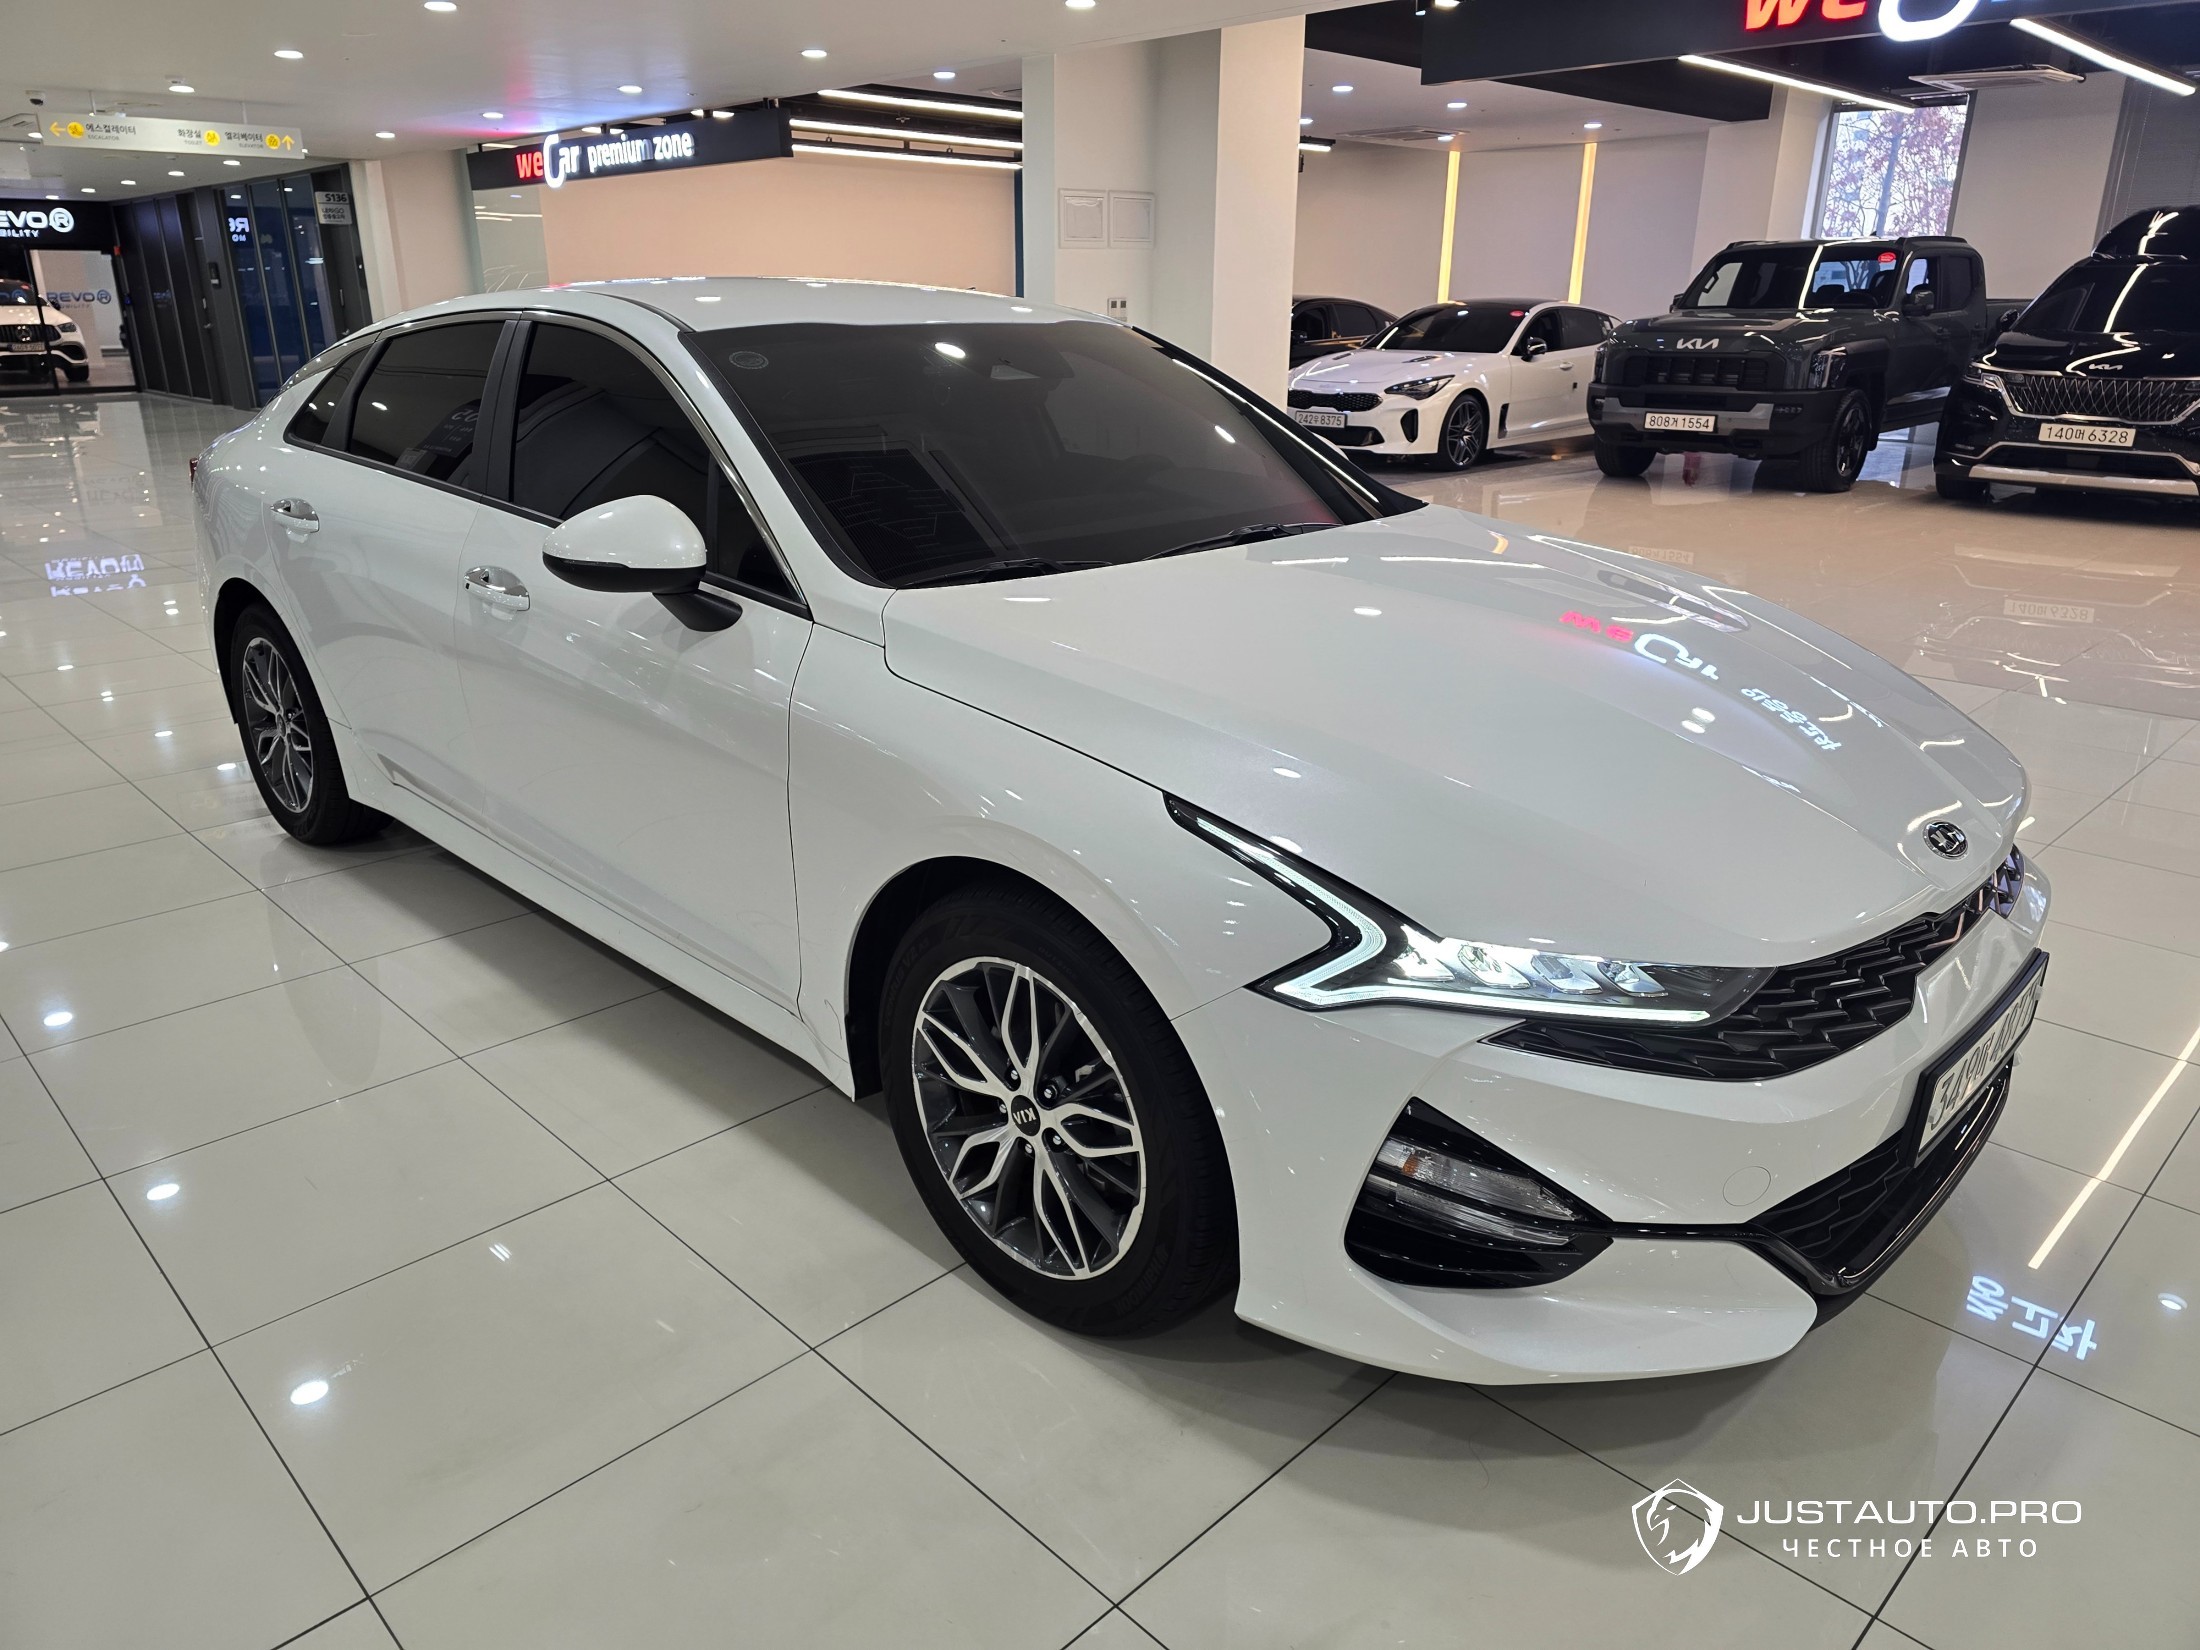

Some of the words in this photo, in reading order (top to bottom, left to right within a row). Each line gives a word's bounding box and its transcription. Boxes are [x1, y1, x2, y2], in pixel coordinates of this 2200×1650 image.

[177, 128, 202, 139] 화장실
[587, 135, 653, 173] premium
[653, 131, 695, 160] zone
[324, 193, 348, 202] S136
[1676, 337, 1720, 350] KIA
[1320, 414, 1342, 426] 8375
[1681, 417, 1710, 429] 1554
[2087, 428, 2129, 444] 6328
